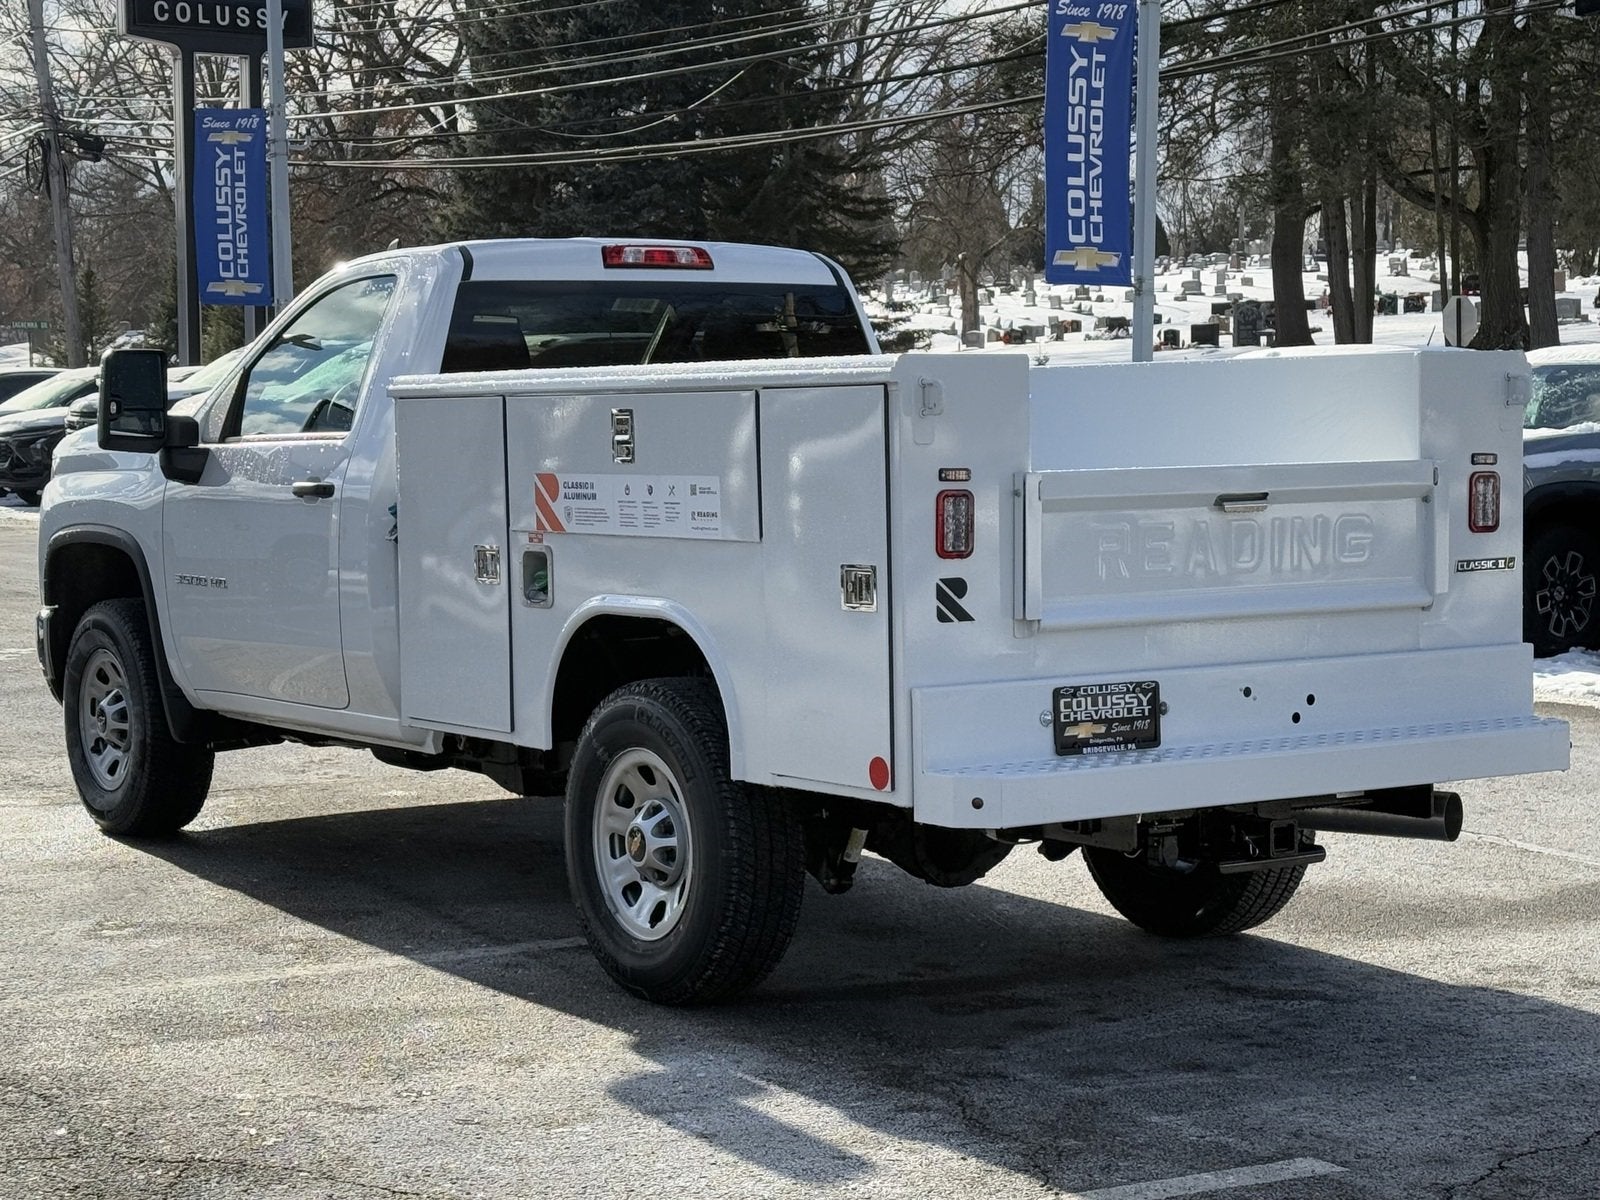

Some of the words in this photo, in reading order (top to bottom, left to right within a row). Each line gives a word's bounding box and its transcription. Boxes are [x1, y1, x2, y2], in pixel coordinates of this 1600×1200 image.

[1056, 0, 1091, 18] Since
[1097, 3, 1128, 20] 1918
[202, 116, 230, 129] Since
[235, 117, 260, 129] 1918
[1067, 45, 1089, 244] COLUSSY
[1089, 46, 1107, 244] CHEVROLET
[215, 146, 235, 278] COLUSSY
[234, 146, 249, 278] CHEVROLET
[562, 481, 589, 490] CLASSIC
[563, 492, 597, 501] ALUMINUM
[1095, 513, 1374, 580] READING
[1457, 560, 1497, 571] CLASSIC
[175, 573, 208, 587] 3500
[1080, 683, 1136, 695] COLUSSY
[1060, 692, 1153, 712] COLUSSY
[1060, 706, 1152, 722] CHEVROLET
[1111, 722, 1131, 733] Since
[1133, 719, 1151, 730] 1918
